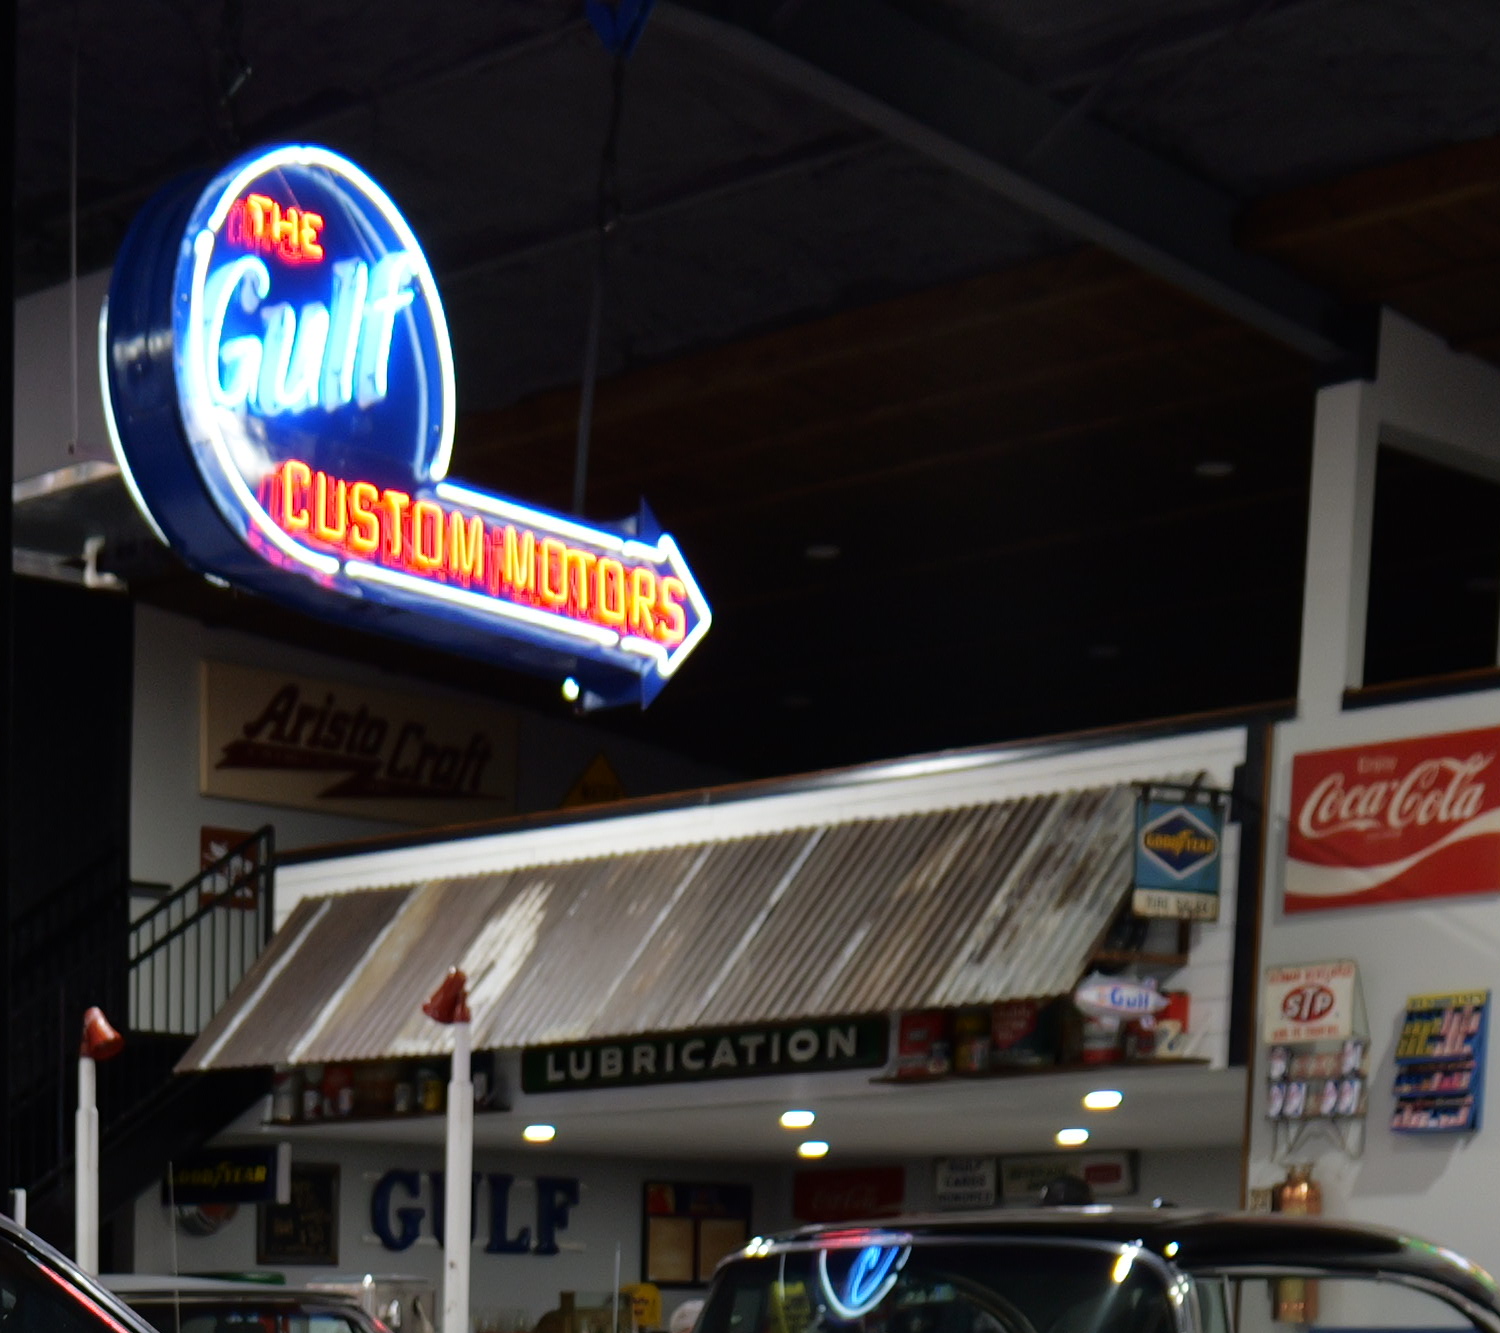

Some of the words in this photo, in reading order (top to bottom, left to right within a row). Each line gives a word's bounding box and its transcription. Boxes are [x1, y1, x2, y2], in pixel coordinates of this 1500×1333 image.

[232, 192, 324, 263] THE
[195, 249, 420, 416] Gulf
[275, 460, 486, 582] CUSTOM
[498, 523, 688, 646] MOTORS
[243, 683, 388, 753] Aristo
[387, 720, 492, 793] Craft
[1109, 986, 1151, 1010] Gulf
[1283, 986, 1334, 1021] STP
[545, 1026, 858, 1083] LUBRICATION
